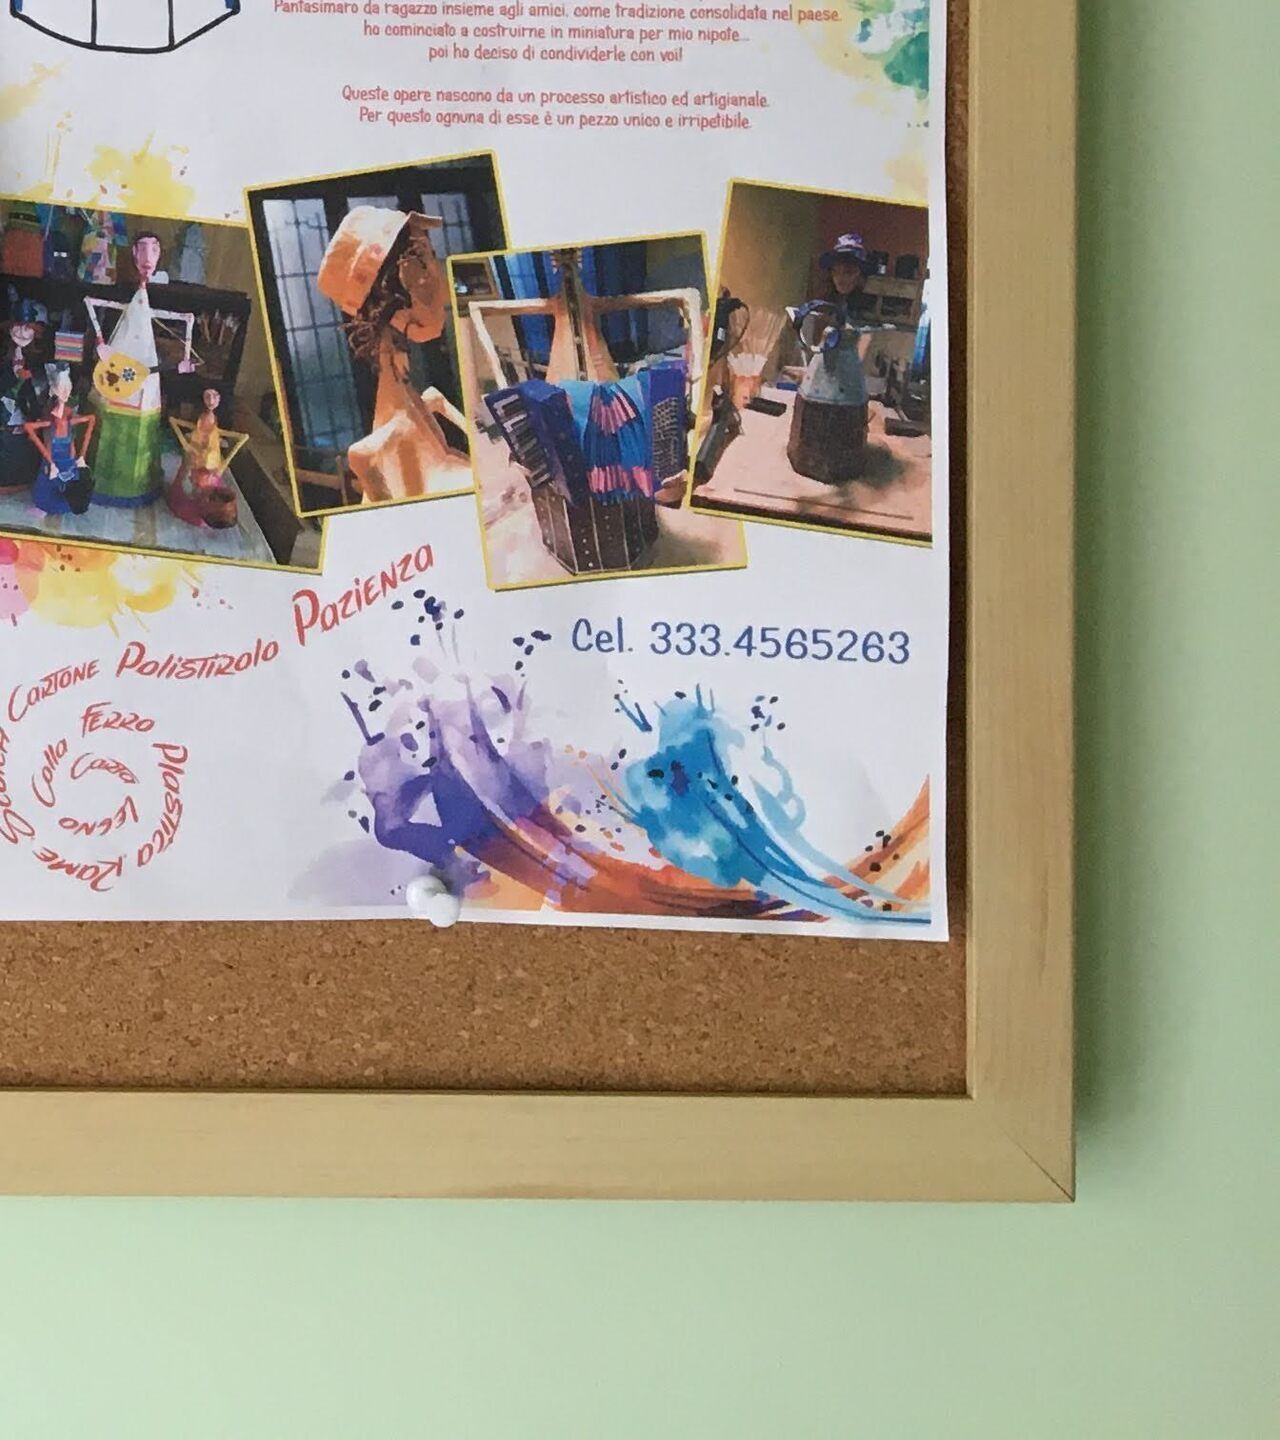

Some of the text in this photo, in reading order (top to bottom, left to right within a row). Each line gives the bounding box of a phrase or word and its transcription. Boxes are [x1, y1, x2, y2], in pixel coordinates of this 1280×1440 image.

[571, 616, 910, 665] Cel. 333.4565263
[80, 701, 154, 737] FERRO
